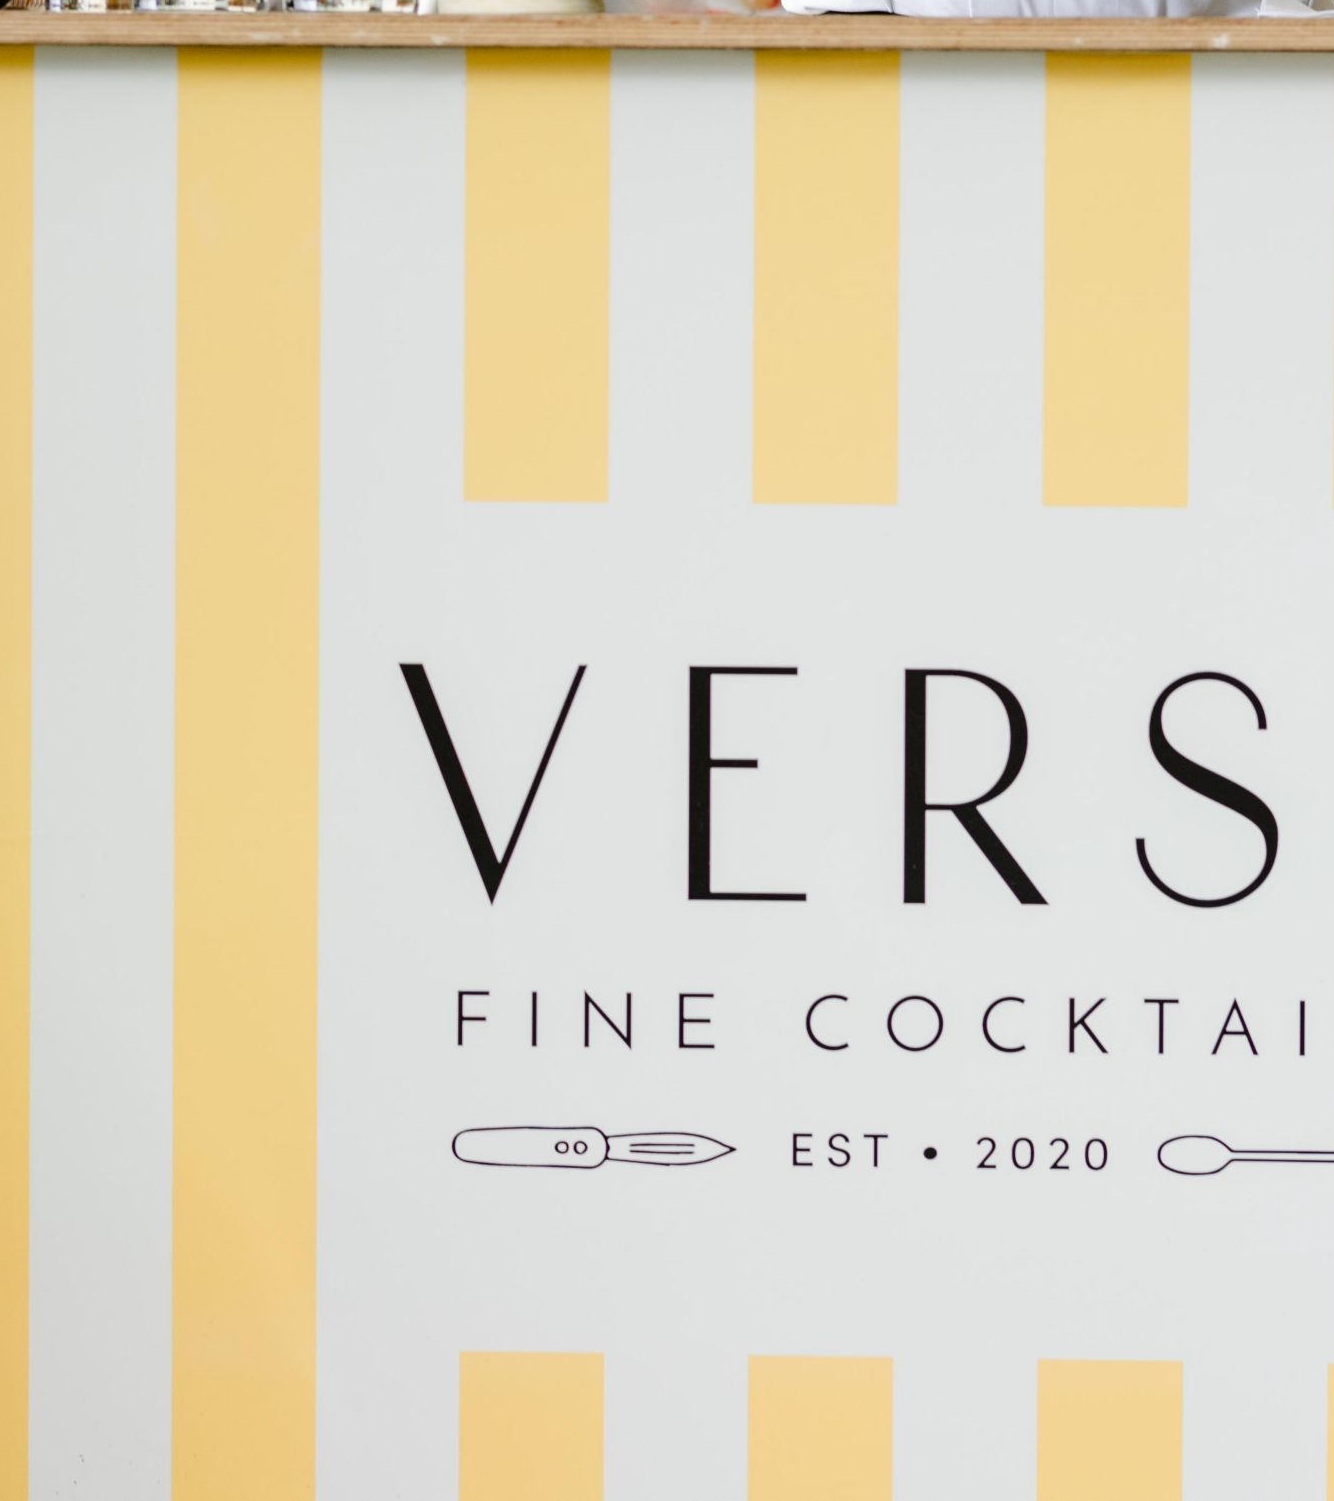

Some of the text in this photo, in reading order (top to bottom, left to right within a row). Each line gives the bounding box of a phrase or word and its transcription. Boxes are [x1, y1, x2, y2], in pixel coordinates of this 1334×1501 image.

[457, 990, 716, 1050] FINE
[792, 1132, 1109, 1172] EST 2020
